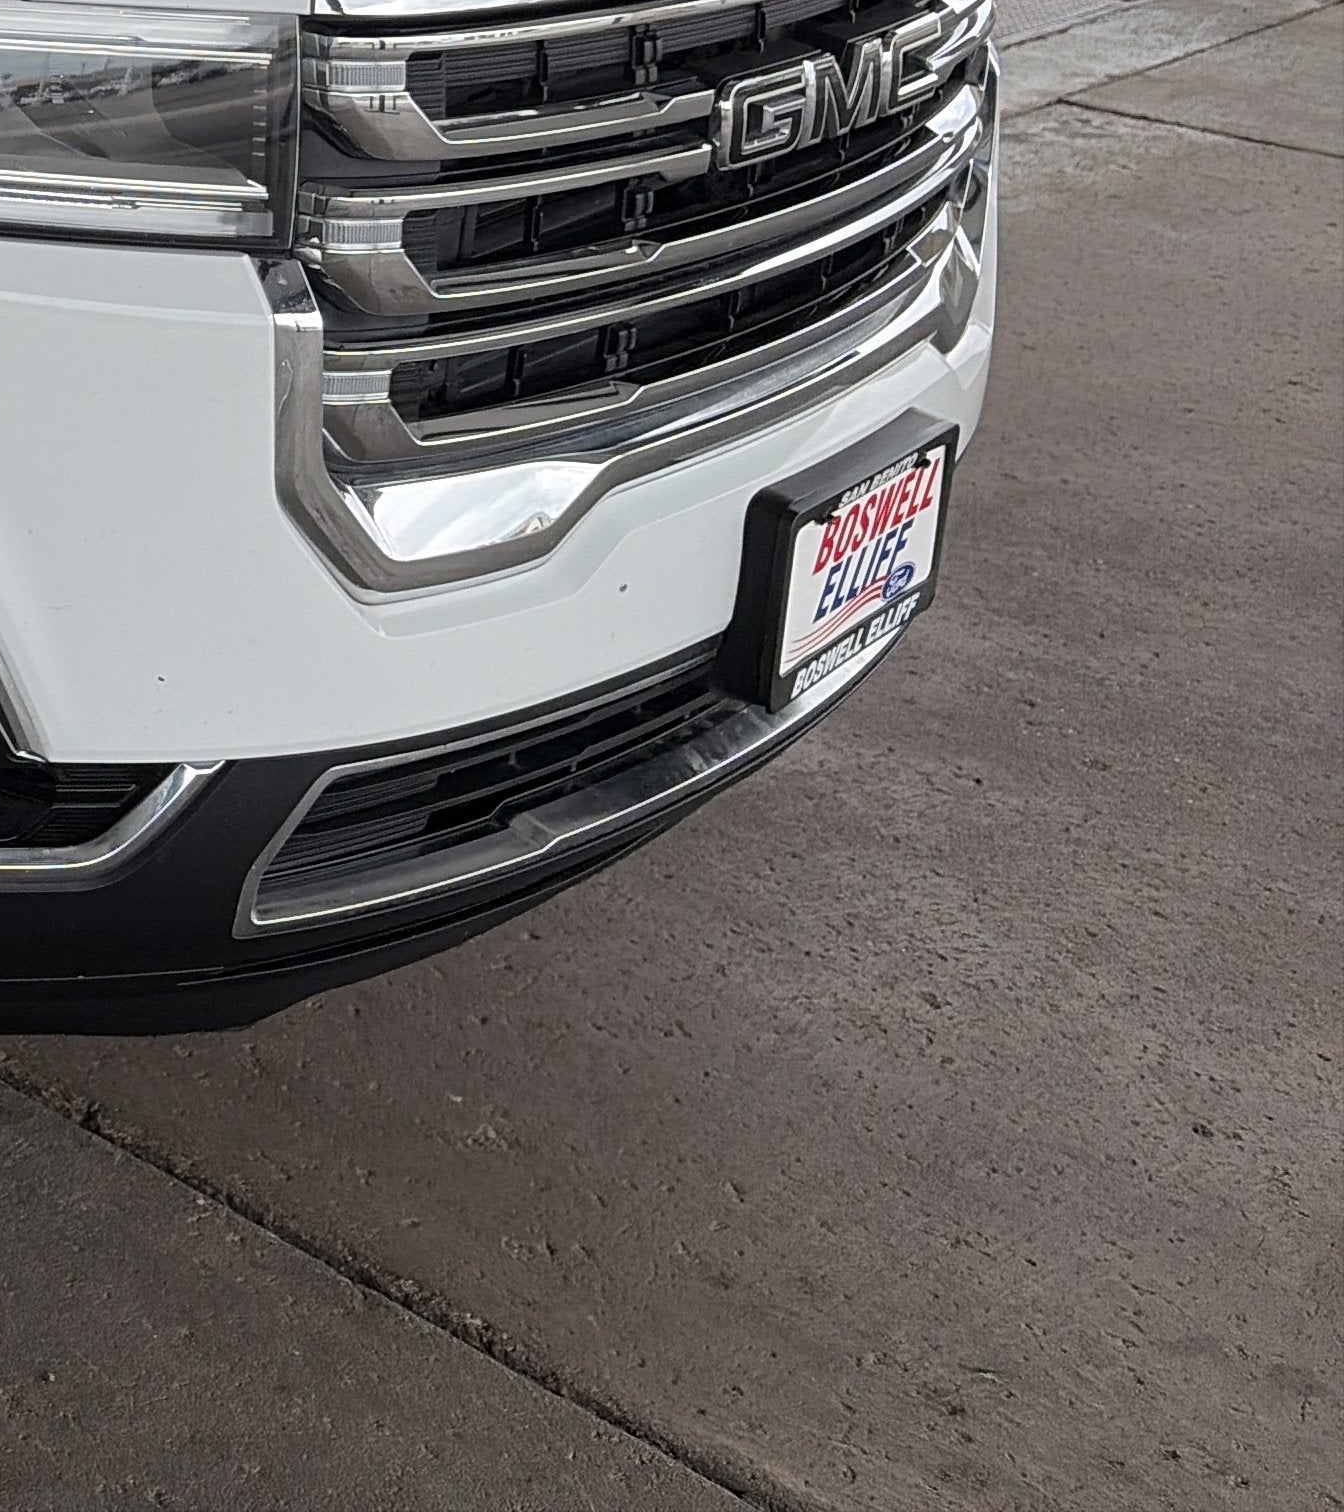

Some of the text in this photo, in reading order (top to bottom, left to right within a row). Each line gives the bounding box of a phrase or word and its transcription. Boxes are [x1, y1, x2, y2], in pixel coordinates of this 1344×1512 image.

[717, 13, 942, 171] GMC
[812, 457, 941, 576] BOSWELL
[838, 452, 917, 508] SAN BENITO
[812, 518, 915, 624] ELLIFF
[790, 591, 921, 700] BOSWELL ELLIFF
